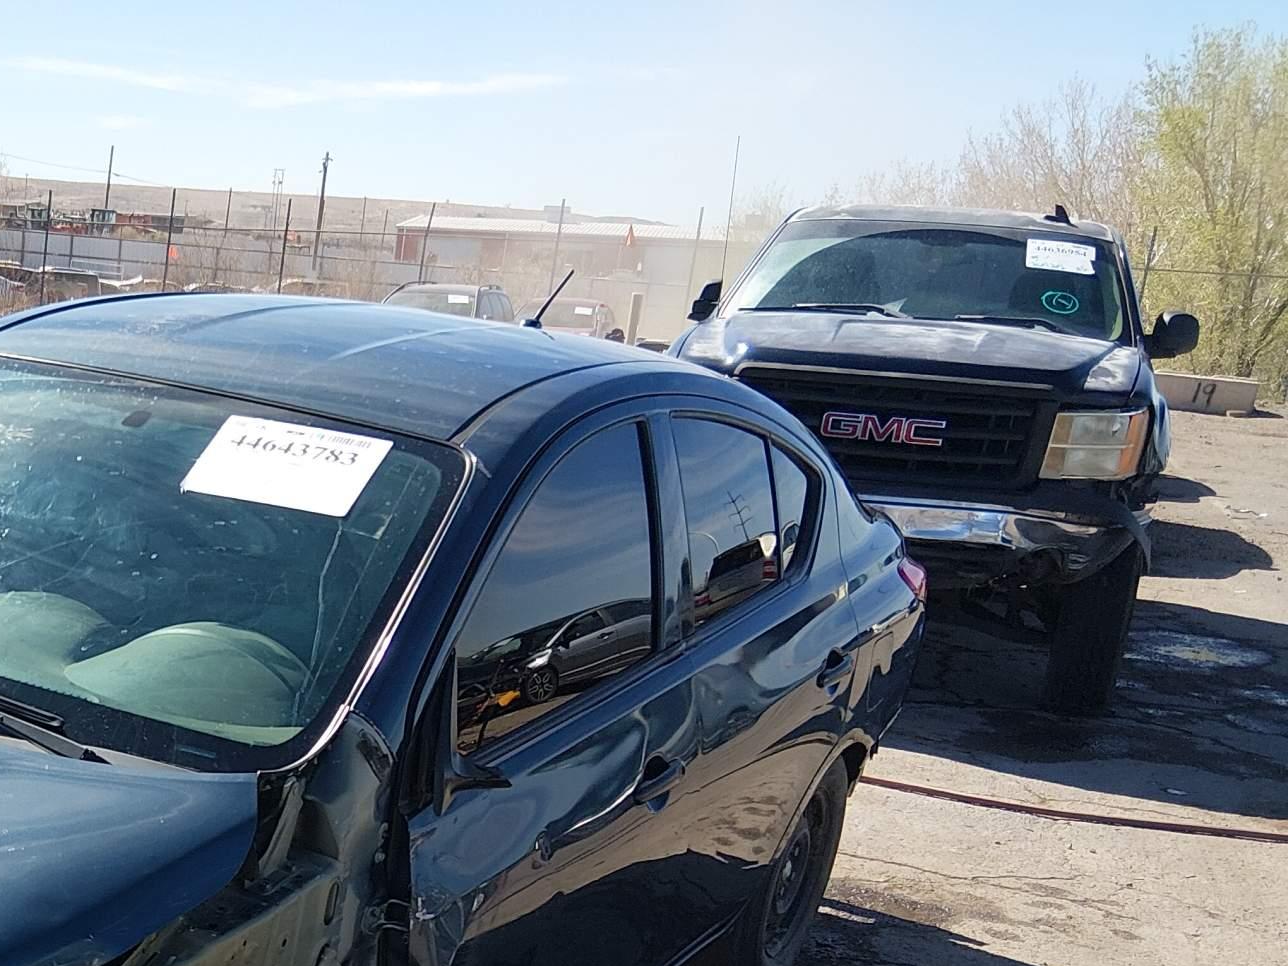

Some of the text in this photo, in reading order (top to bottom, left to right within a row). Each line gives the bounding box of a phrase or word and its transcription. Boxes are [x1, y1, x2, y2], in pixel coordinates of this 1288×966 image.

[1191, 381, 1217, 406] 19
[820, 411, 947, 447] GMC
[230, 434, 360, 466] 44643783
